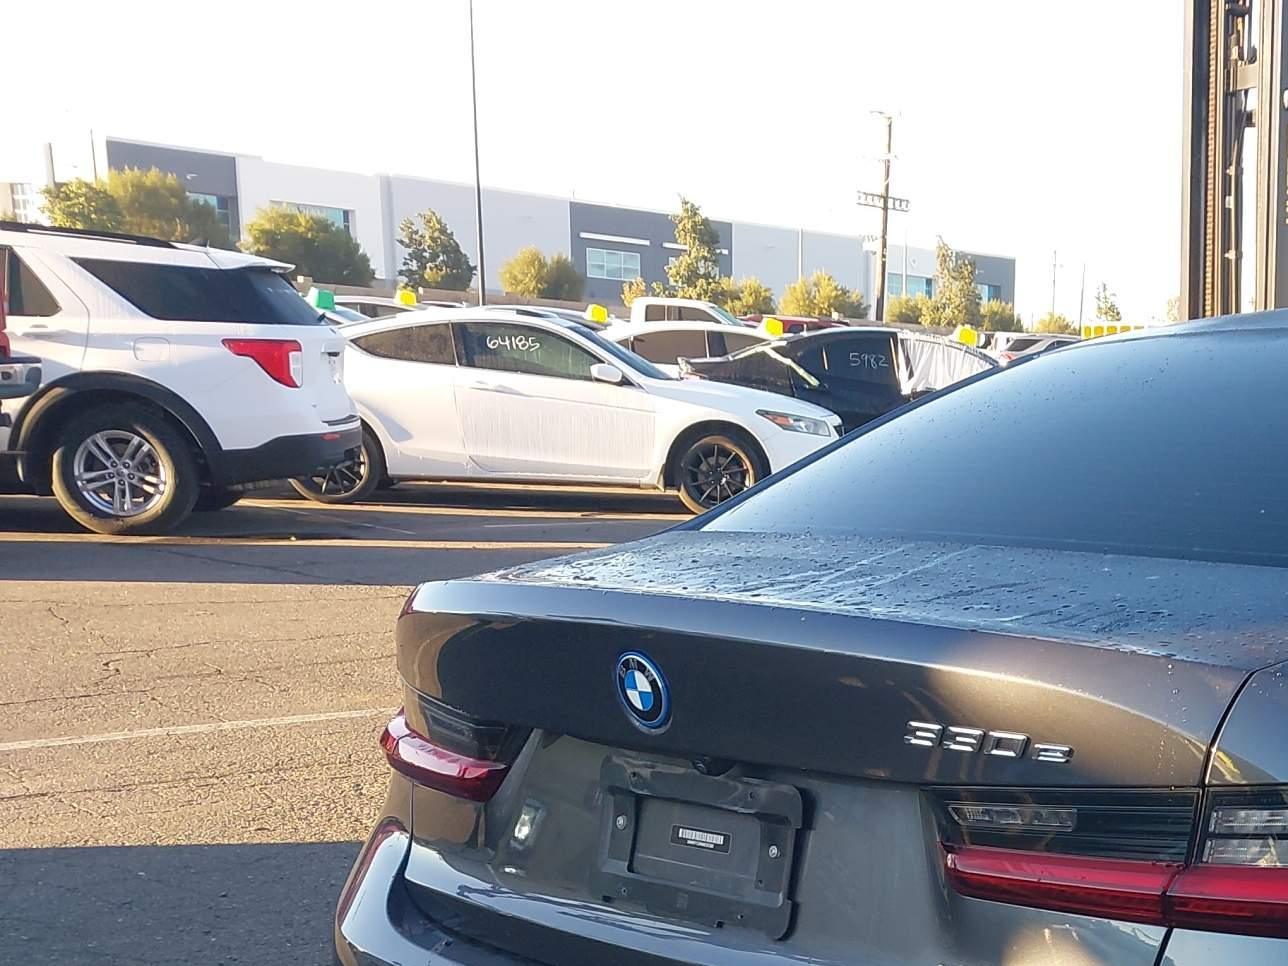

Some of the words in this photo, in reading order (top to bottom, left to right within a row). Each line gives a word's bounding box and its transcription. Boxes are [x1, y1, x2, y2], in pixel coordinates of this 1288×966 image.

[486, 335, 541, 352] 64185
[849, 352, 889, 369] 5982
[620, 658, 656, 682] BMW
[904, 720, 1076, 764] 330e
